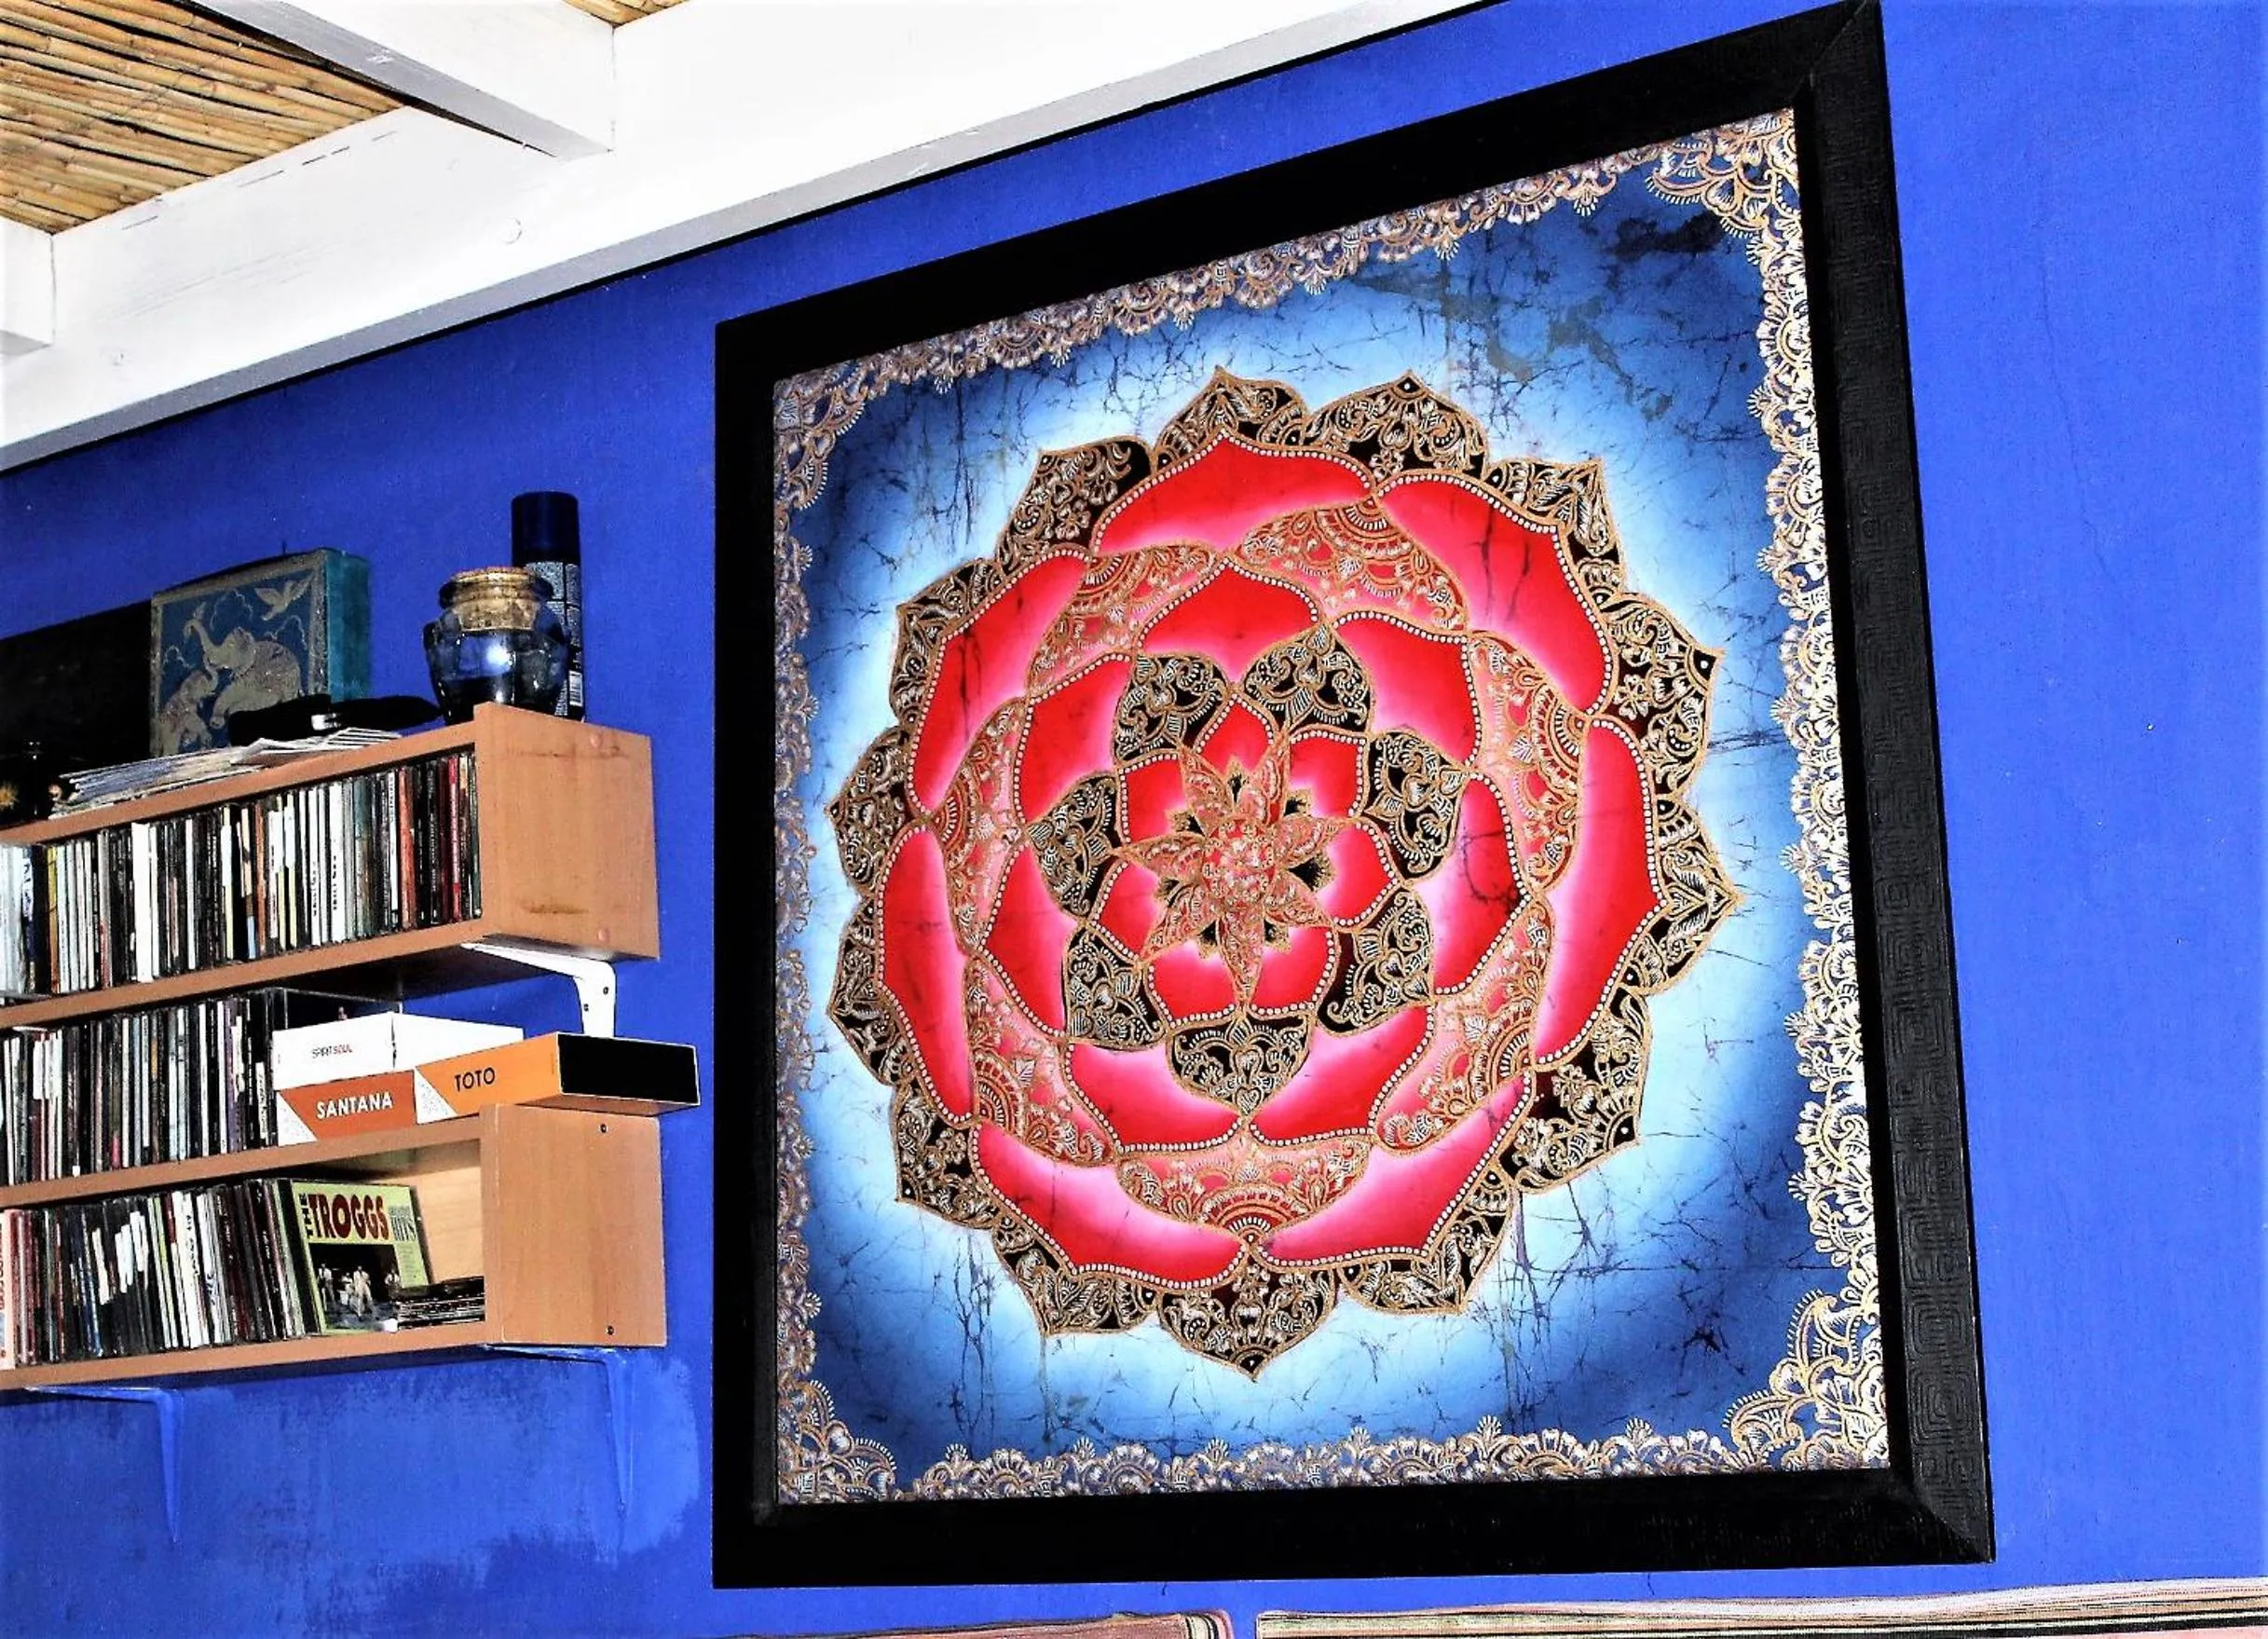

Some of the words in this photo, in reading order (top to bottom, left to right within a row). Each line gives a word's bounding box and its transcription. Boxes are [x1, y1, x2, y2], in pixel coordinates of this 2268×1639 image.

[455, 1067, 495, 1091] TOTO
[317, 1091, 392, 1119] SANTANA
[299, 1193, 313, 1239] THE
[308, 1194, 389, 1240] TROGGS
